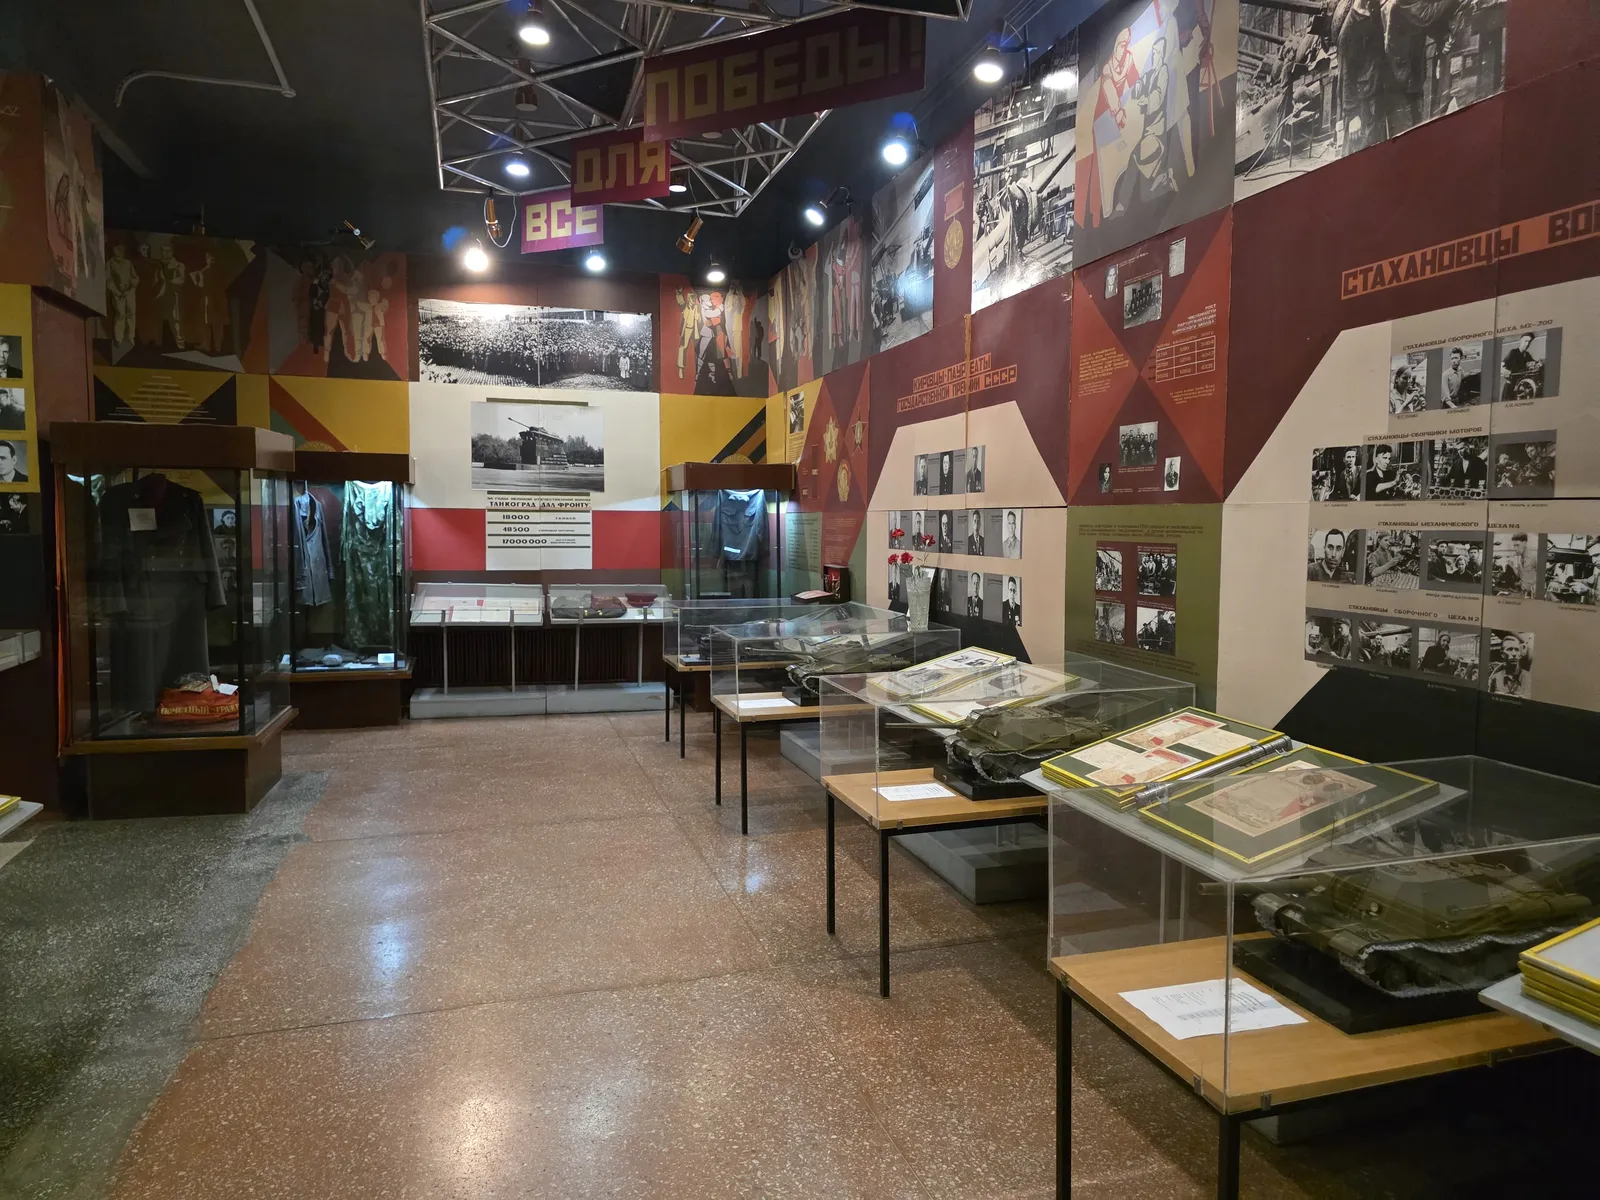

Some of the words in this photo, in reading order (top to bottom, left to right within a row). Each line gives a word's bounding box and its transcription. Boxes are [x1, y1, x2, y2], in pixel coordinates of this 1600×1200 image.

[646, 15, 923, 127] ПОБЕДЫ!
[574, 141, 666, 193] ДЛЯ
[526, 200, 597, 242] ВСЕ
[1343, 225, 1520, 296] СТАХАНОВЦЫ
[1548, 203, 1600, 244] ВО
[1403, 339, 1446, 351] СТАХАНОВЦЫ
[1448, 330, 1493, 342] СБОРОЧНОГО
[984, 365, 1017, 388] СССР
[1348, 604, 1388, 613] СТАХАНОВЦЫ
[1394, 608, 1438, 618] СБОРОЧНОГО
